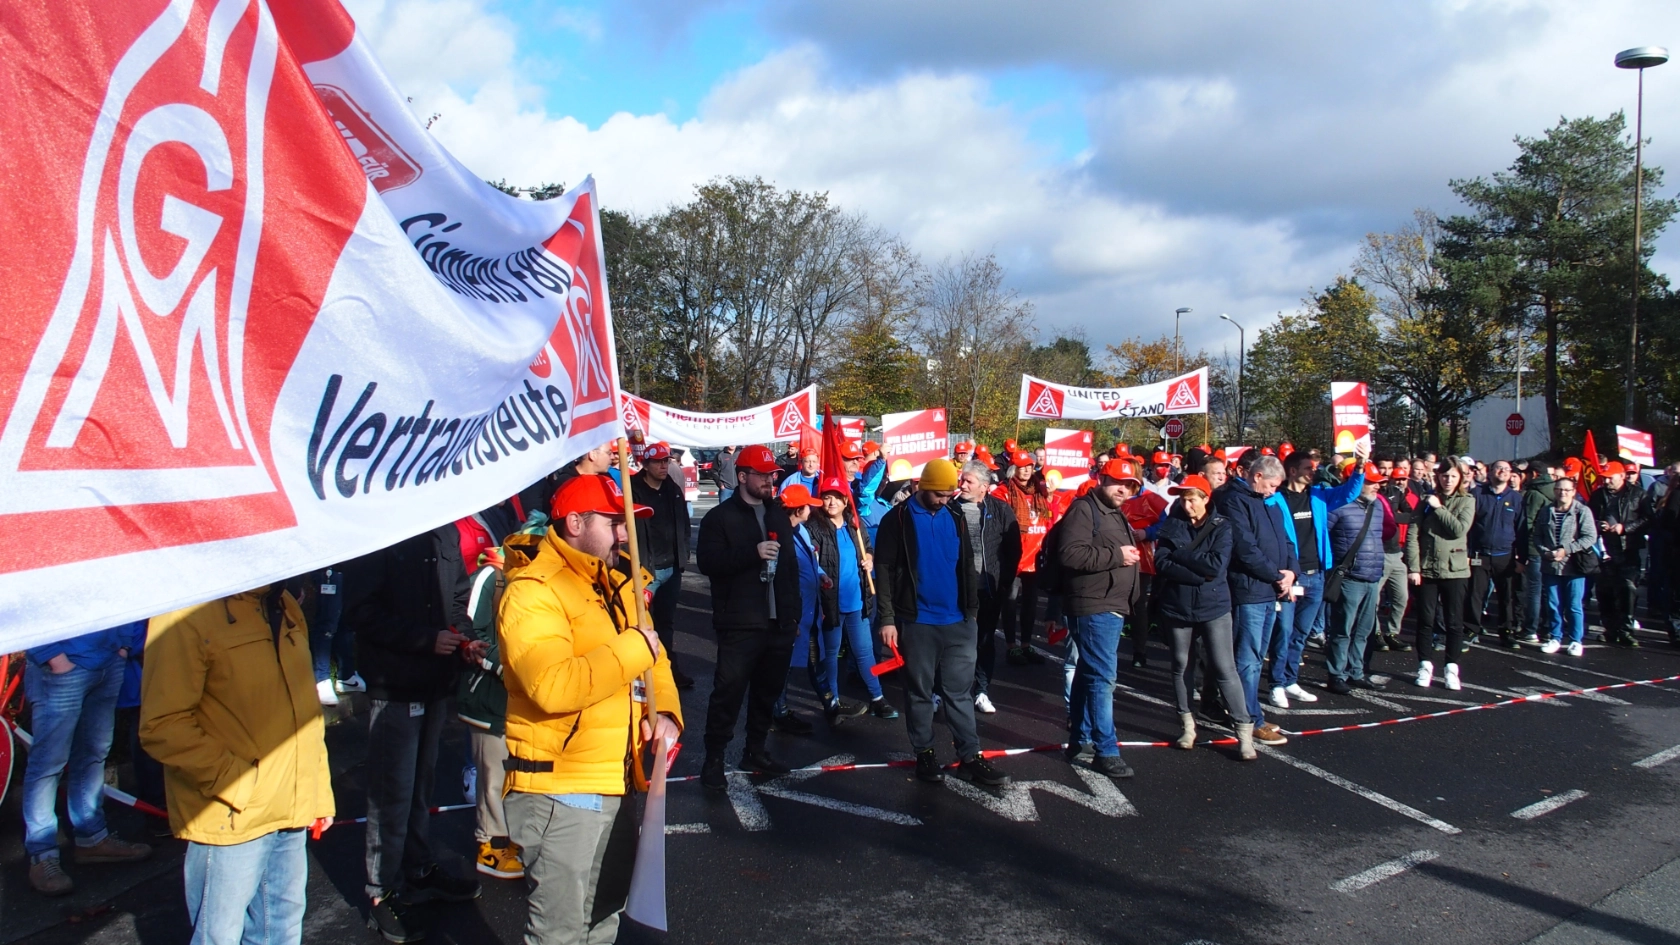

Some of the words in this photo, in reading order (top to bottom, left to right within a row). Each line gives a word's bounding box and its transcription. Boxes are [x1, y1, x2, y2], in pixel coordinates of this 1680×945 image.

[1068, 389, 1120, 400] UNITED
[666, 417, 756, 430] SCIENTIFIC
[1167, 424, 1182, 433] STOP
[1507, 420, 1524, 429] STOP
[308, 373, 568, 500] Vertrauensleute
[926, 431, 935, 440] ES
[889, 438, 946, 456] VERDIENT!
[1046, 455, 1089, 468] VERDIENT!
